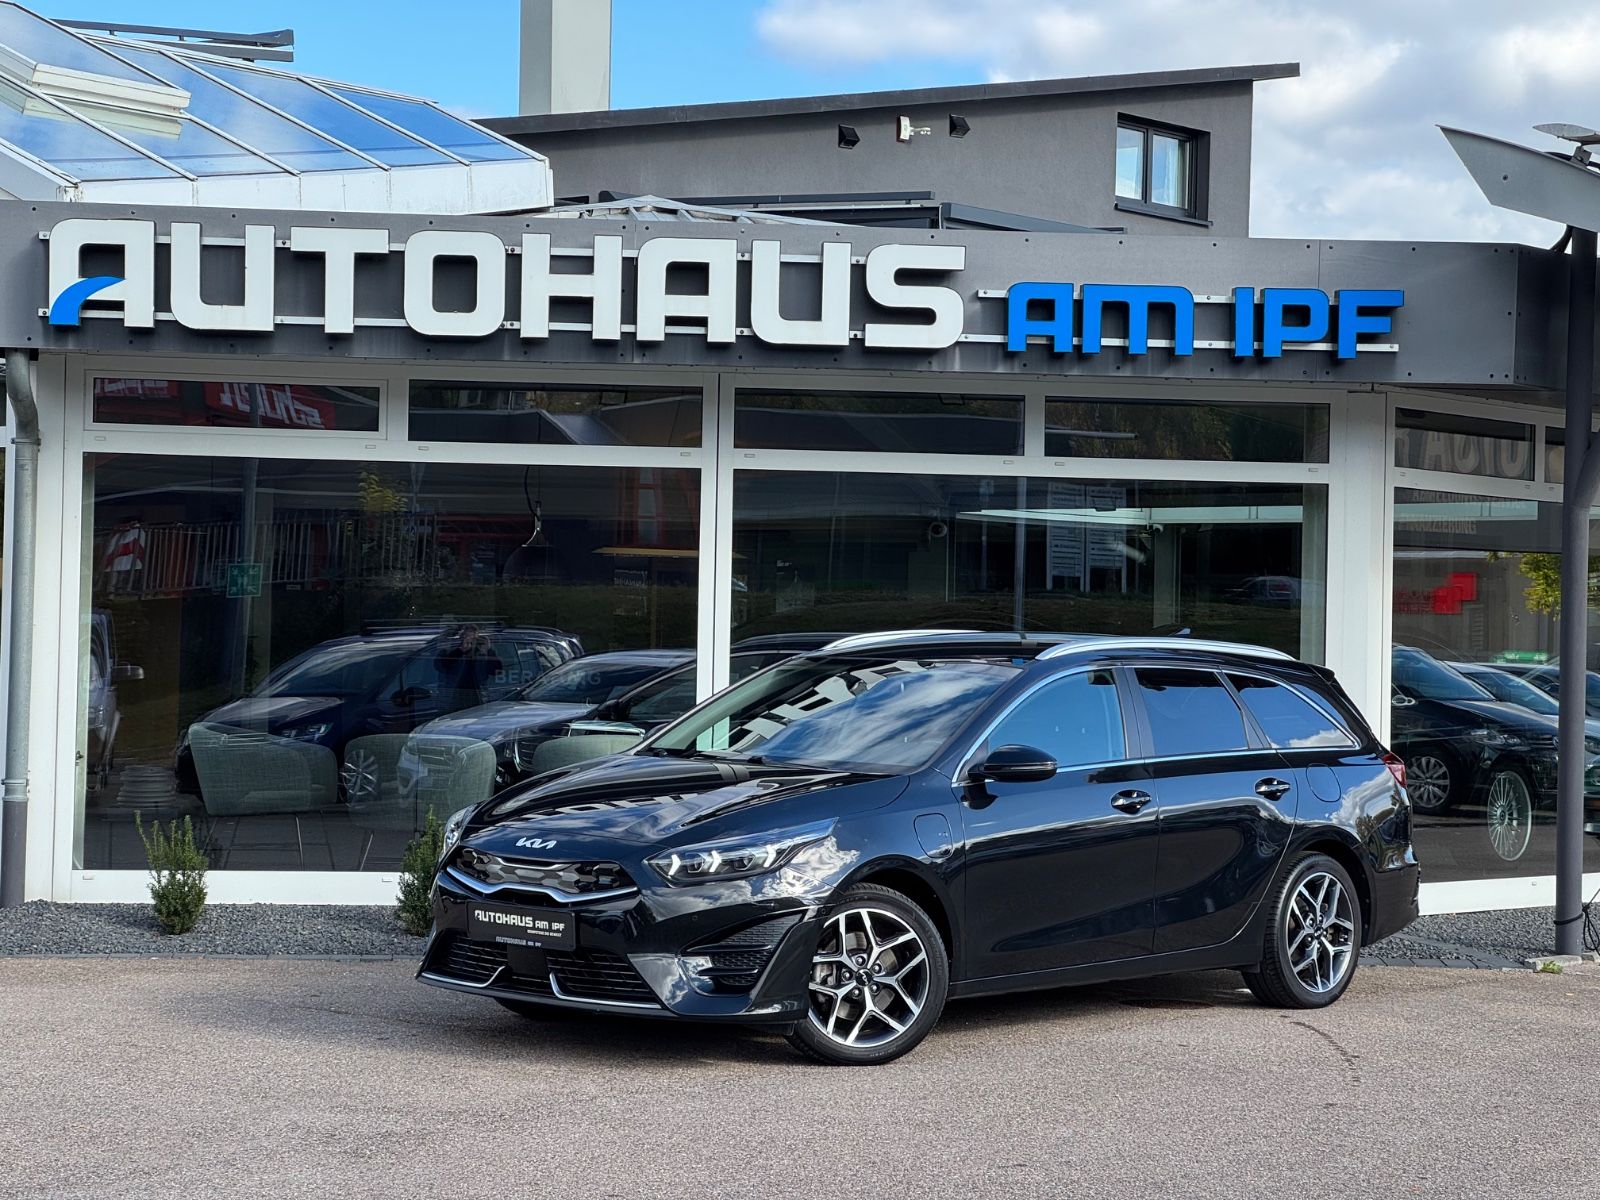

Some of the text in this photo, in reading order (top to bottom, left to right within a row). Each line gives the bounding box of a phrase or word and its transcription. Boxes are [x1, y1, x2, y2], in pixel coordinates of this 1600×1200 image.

[47, 218, 1404, 359] AUTOHAUS AM IPF
[475, 910, 564, 931] AUTOHAUS AM IPF
